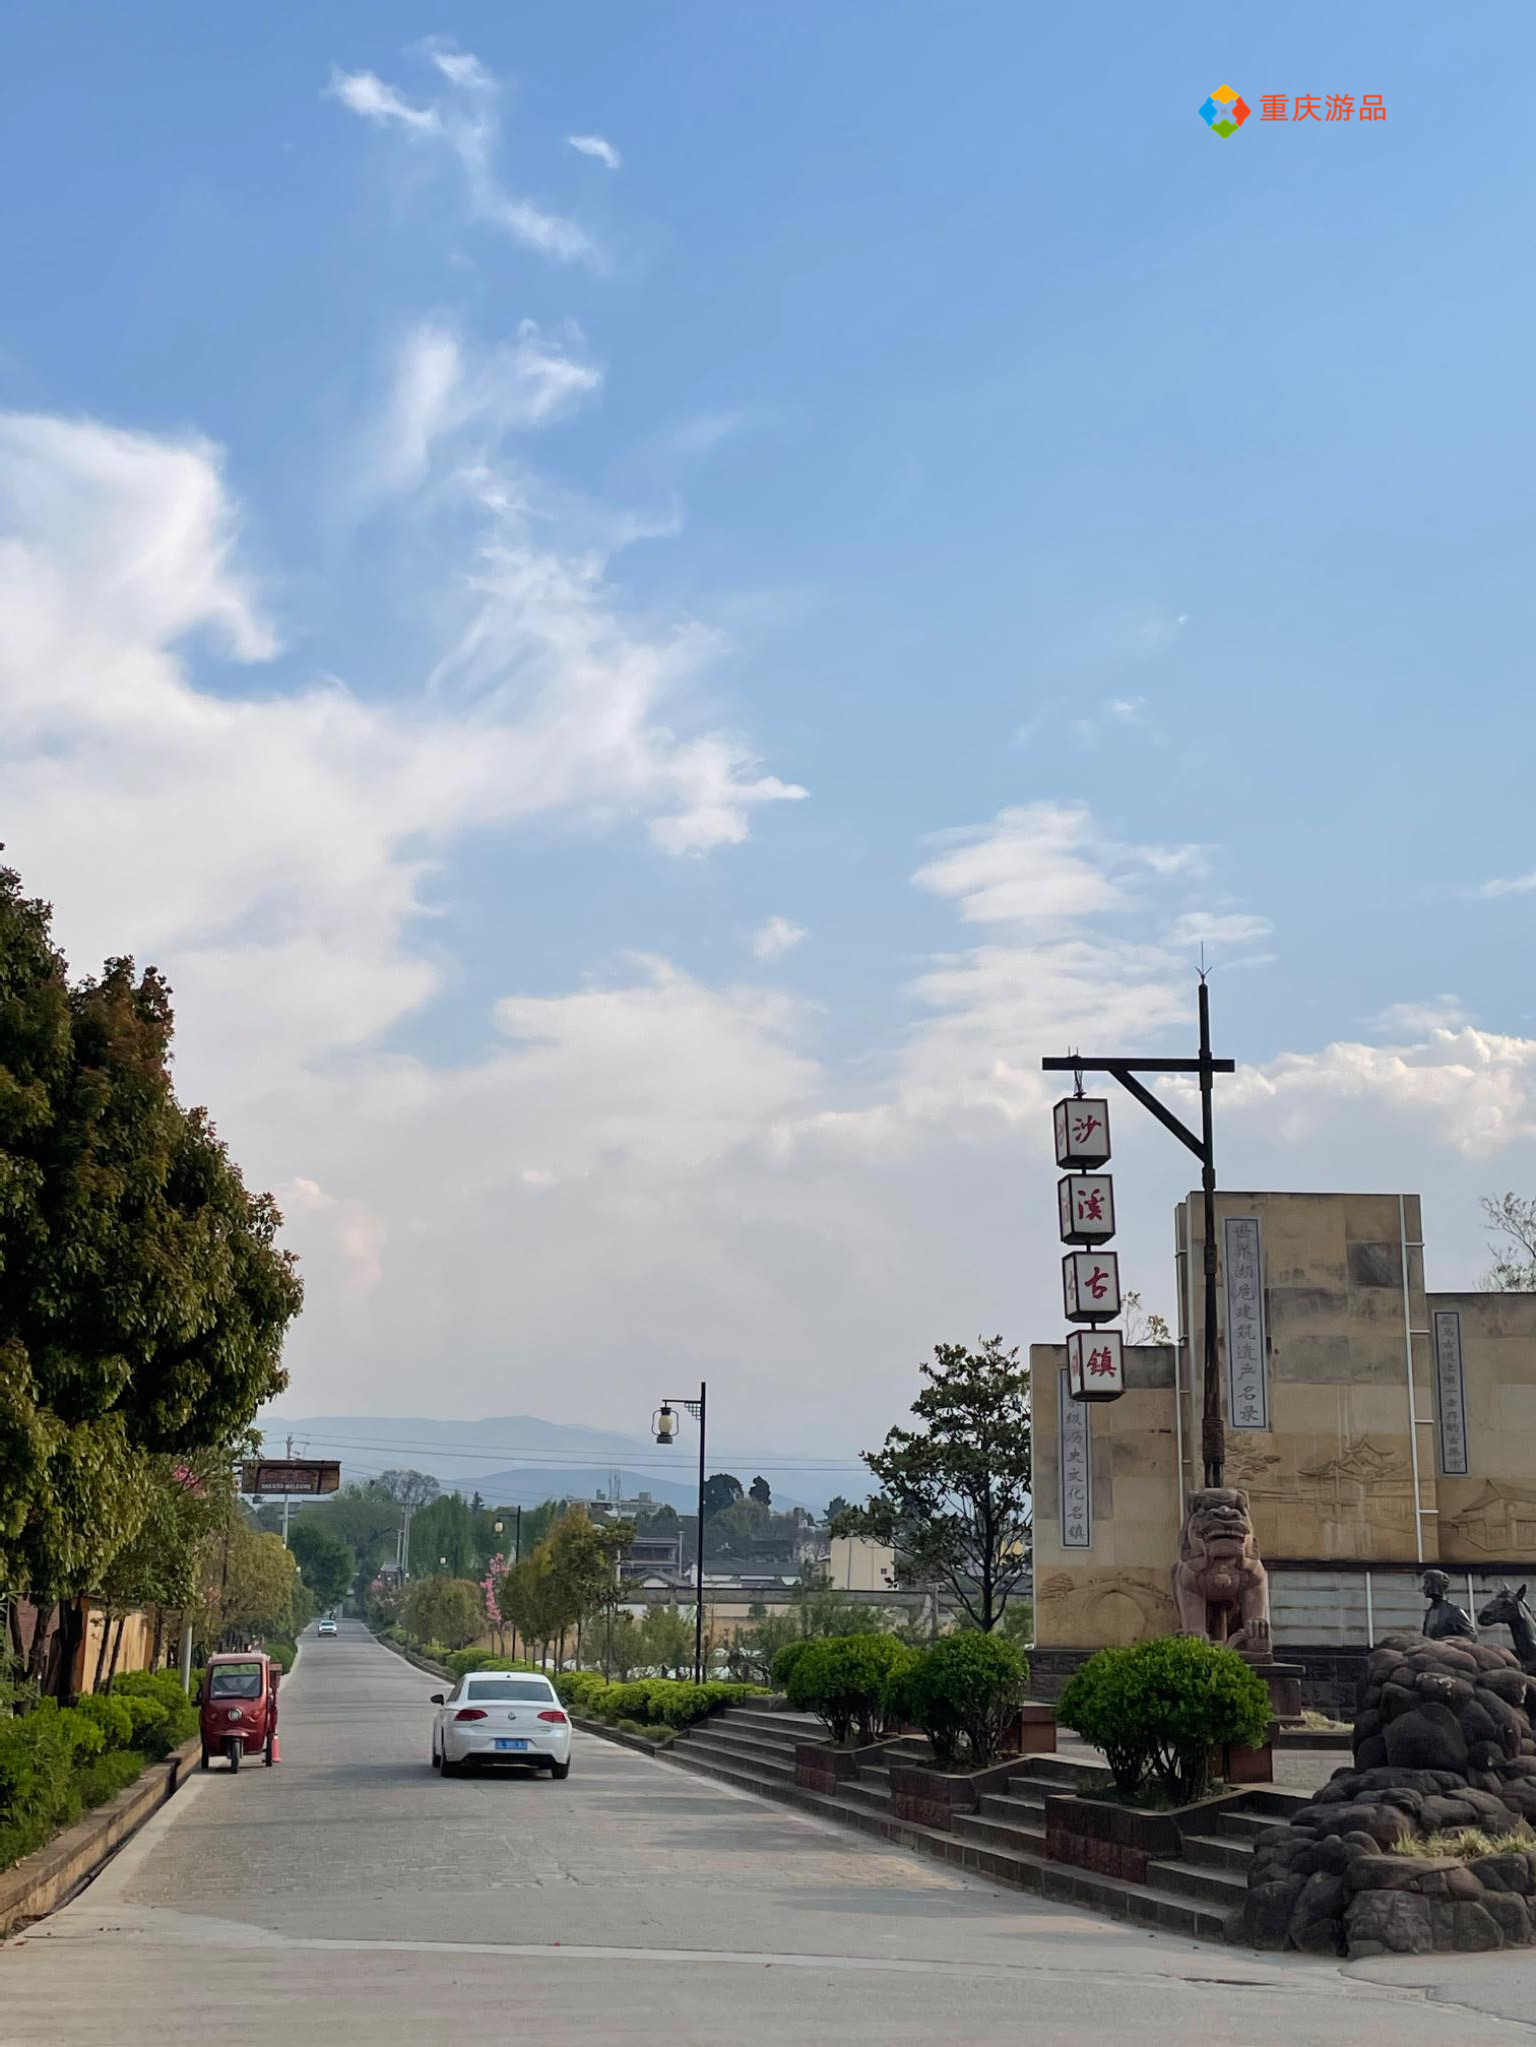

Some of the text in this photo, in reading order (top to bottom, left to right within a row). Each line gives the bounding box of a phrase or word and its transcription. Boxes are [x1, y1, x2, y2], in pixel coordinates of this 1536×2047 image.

[1065, 1400, 1087, 1541] 级历史文化名镇
